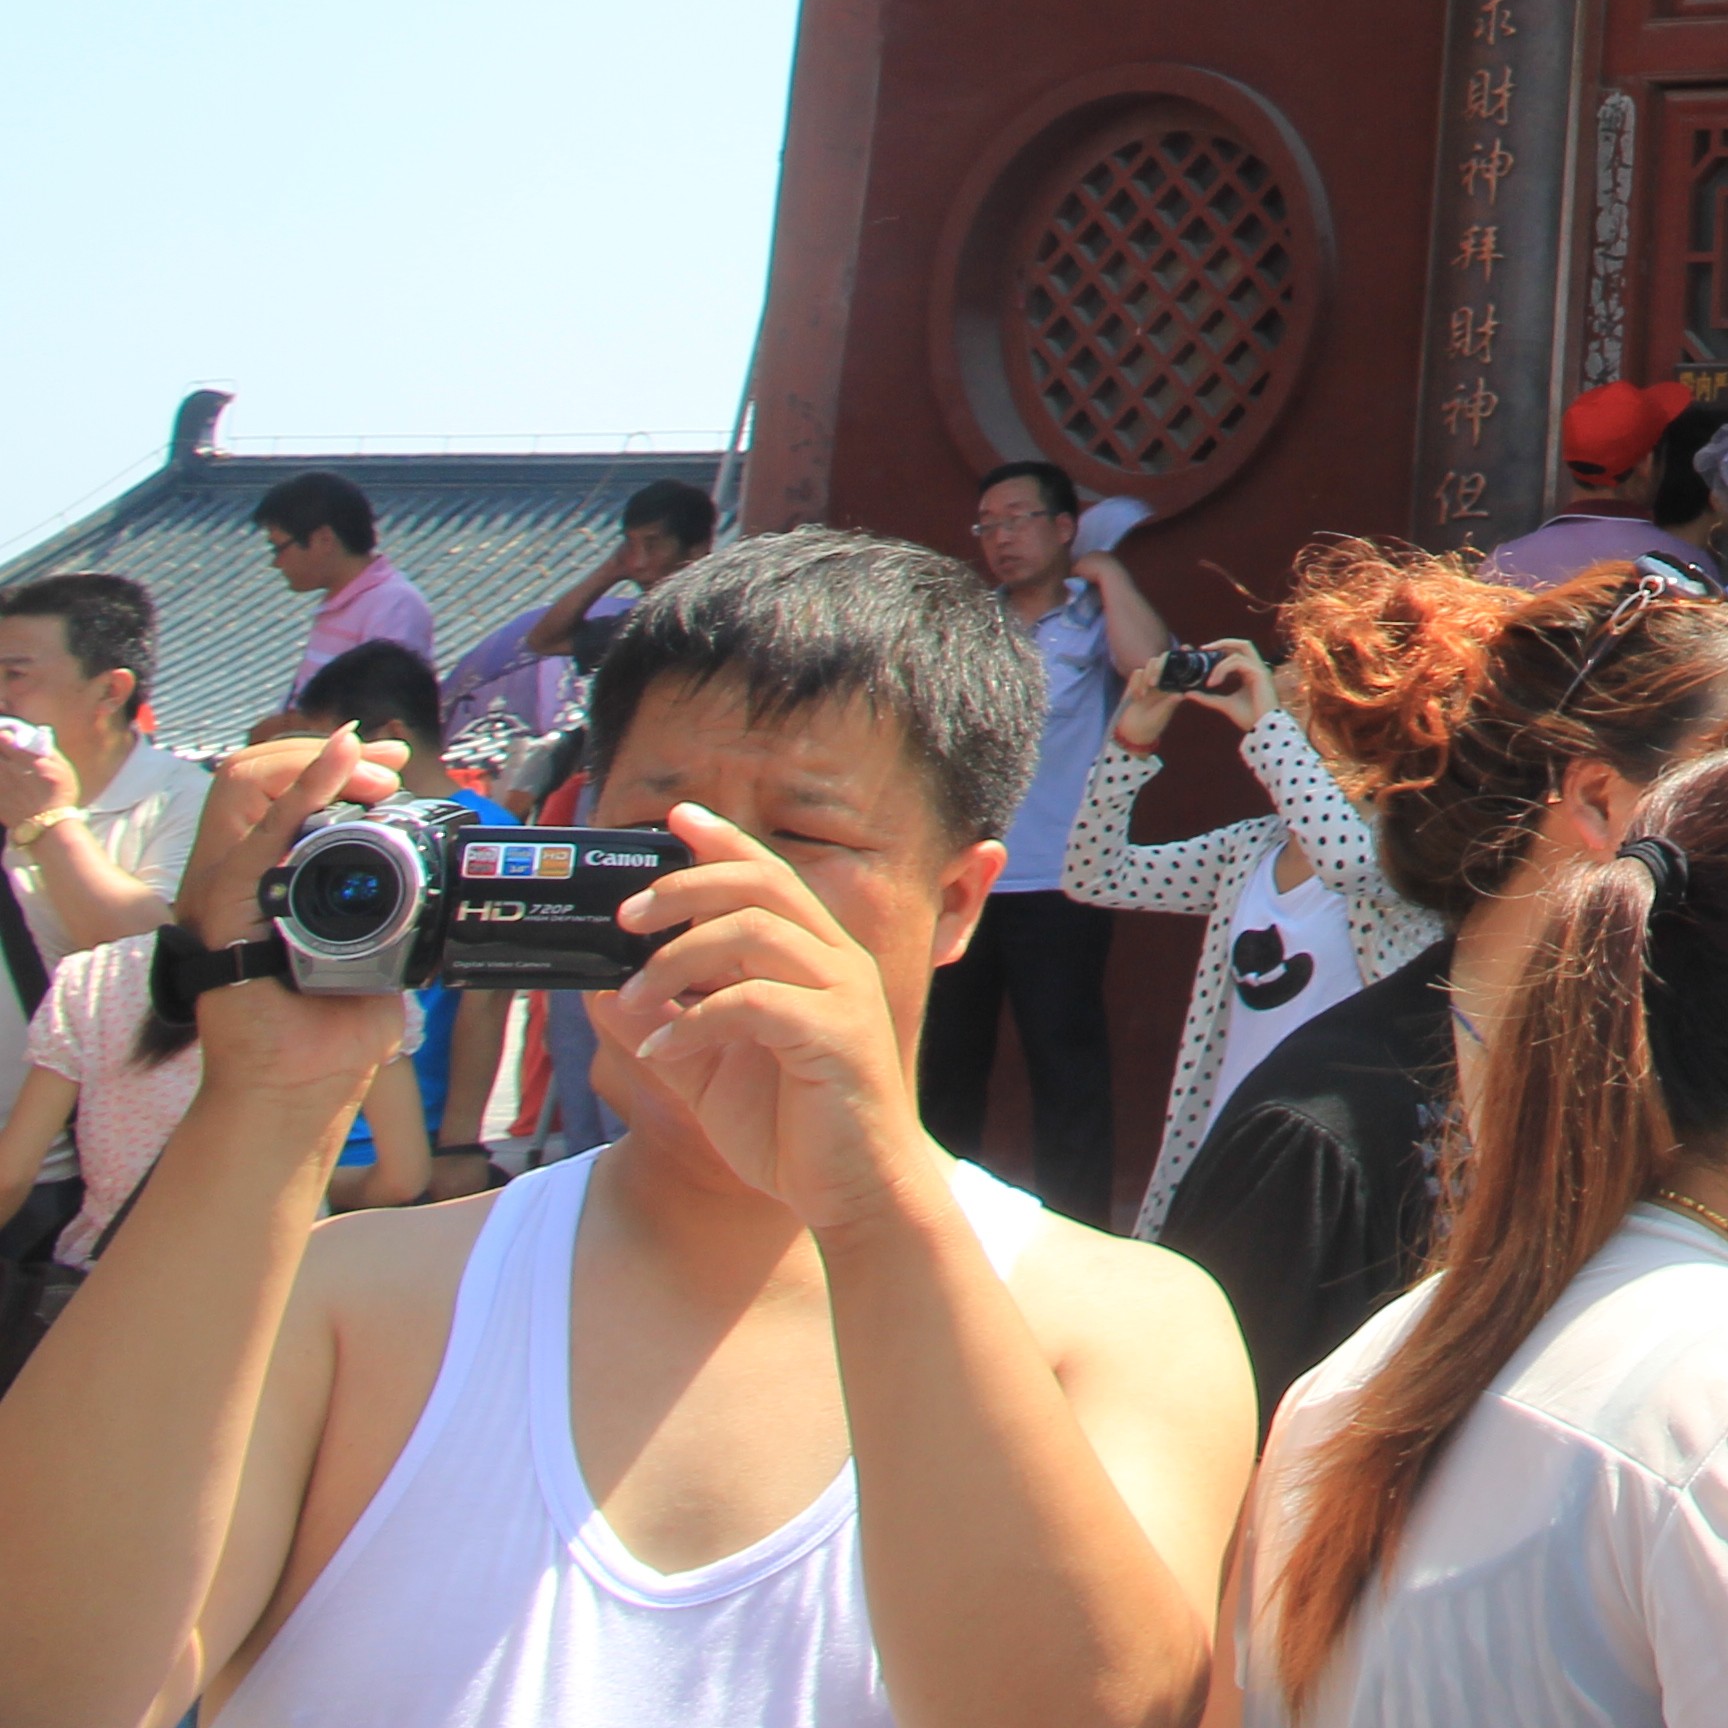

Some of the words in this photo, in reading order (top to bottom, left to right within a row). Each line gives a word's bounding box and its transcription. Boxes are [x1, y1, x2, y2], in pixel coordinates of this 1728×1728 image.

[584, 849, 659, 867] Canon
[551, 915, 611, 923] DEFINITION
[452, 960, 484, 969] Digital
[487, 960, 513, 968] Video
[516, 961, 552, 969] Camera
